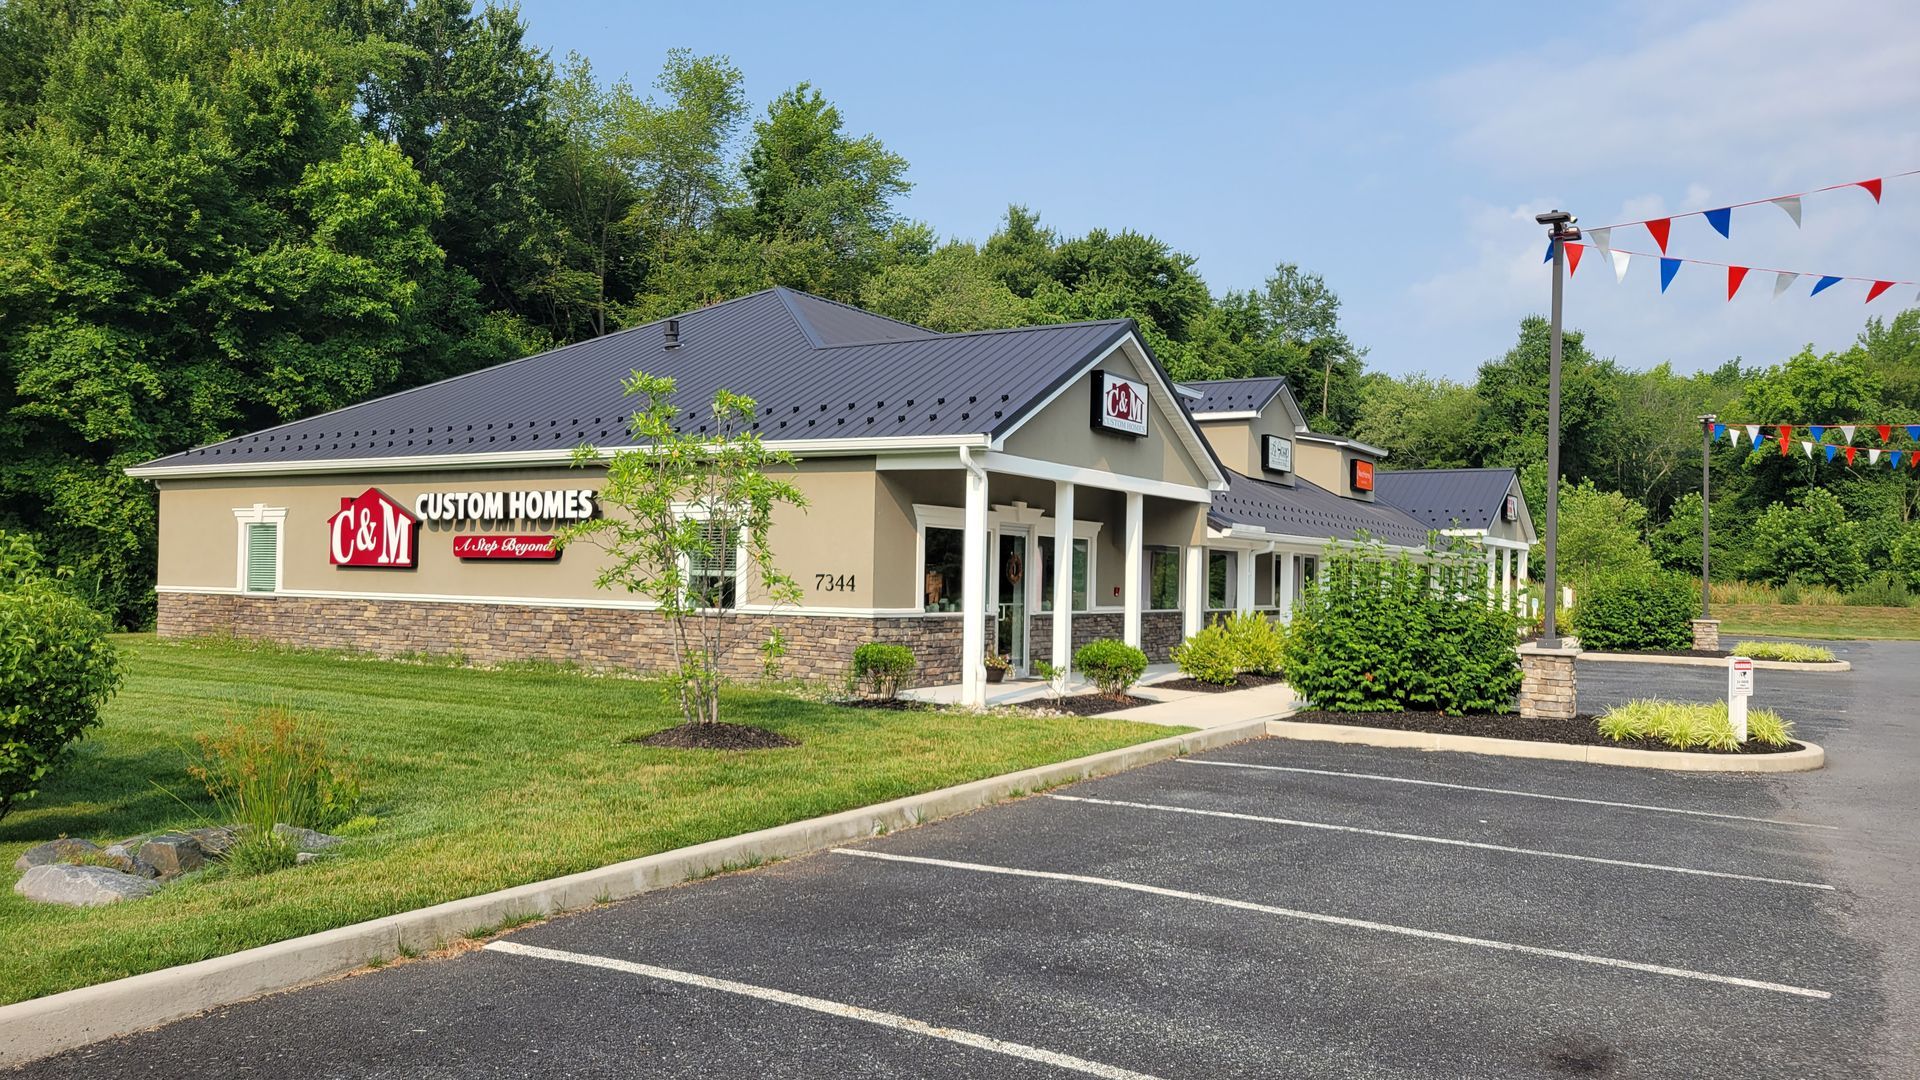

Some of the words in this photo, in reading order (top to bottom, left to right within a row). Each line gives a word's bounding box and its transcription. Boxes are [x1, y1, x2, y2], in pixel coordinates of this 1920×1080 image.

[1107, 388, 1142, 422] C&M
[415, 492, 504, 520] CUSTOM
[509, 490, 593, 519] HOMES
[332, 498, 411, 563] C&M
[455, 538, 471, 551] A
[472, 538, 498, 555] Step
[501, 537, 555, 555] Beyond
[816, 574, 856, 592] 7344
